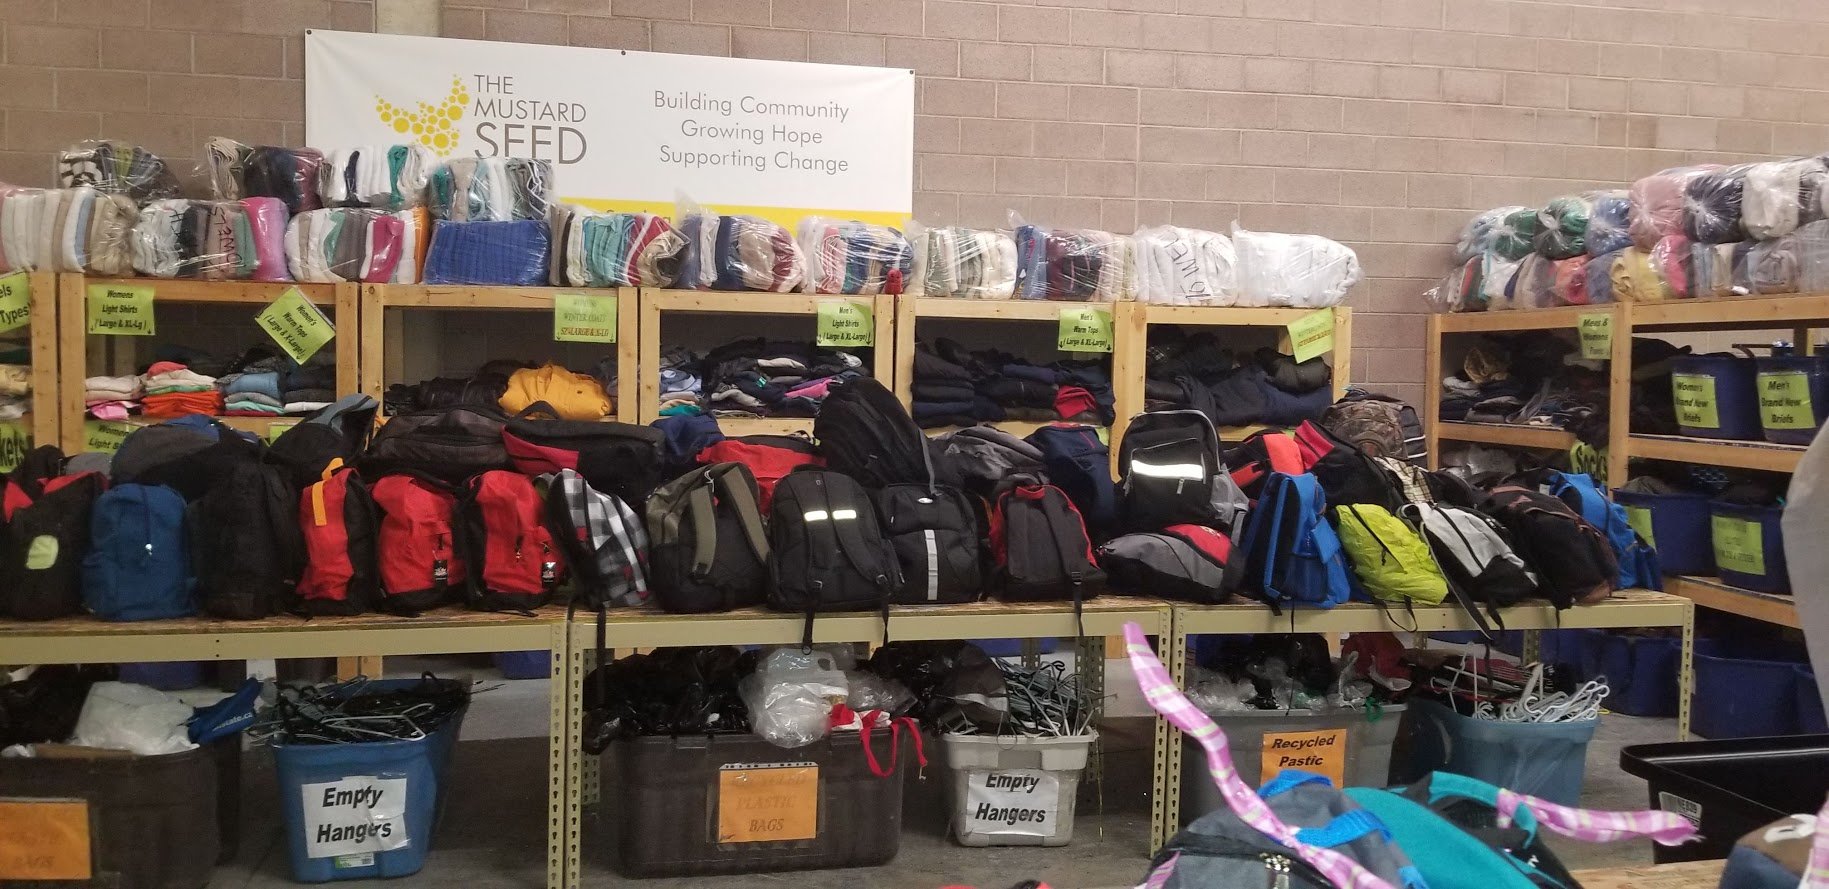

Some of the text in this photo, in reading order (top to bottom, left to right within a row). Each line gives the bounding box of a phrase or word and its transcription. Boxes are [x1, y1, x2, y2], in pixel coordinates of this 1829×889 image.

[474, 74, 513, 94] THE
[474, 98, 587, 123] MUSTARD
[654, 90, 849, 123] Building Community
[681, 119, 823, 147] Growing Hope
[659, 144, 849, 175] Supporting Change
[107, 290, 133, 299] Womens
[102, 304, 138, 314] Light Shirts
[296, 304, 317, 326] Women's
[99, 319, 117, 329] Large
[267, 316, 282, 331] Large
[283, 311, 308, 338] Warm Tops
[832, 320, 860, 328] Light Shirts
[1073, 325, 1099, 335] Warm Tops
[826, 333, 840, 341] Large
[1066, 338, 1080, 347] Large
[1761, 397, 1801, 407] Brand New
[1771, 414, 1794, 424] Briefs
[89, 438, 110, 450] Light
[1272, 734, 1336, 751] Recycled
[1279, 755, 1324, 767] Pastic
[986, 773, 1040, 794] Empty
[322, 784, 384, 809] Empty
[975, 802, 1047, 826] Hangers
[316, 822, 392, 844] Hangers
[748, 818, 785, 833] BAGS
